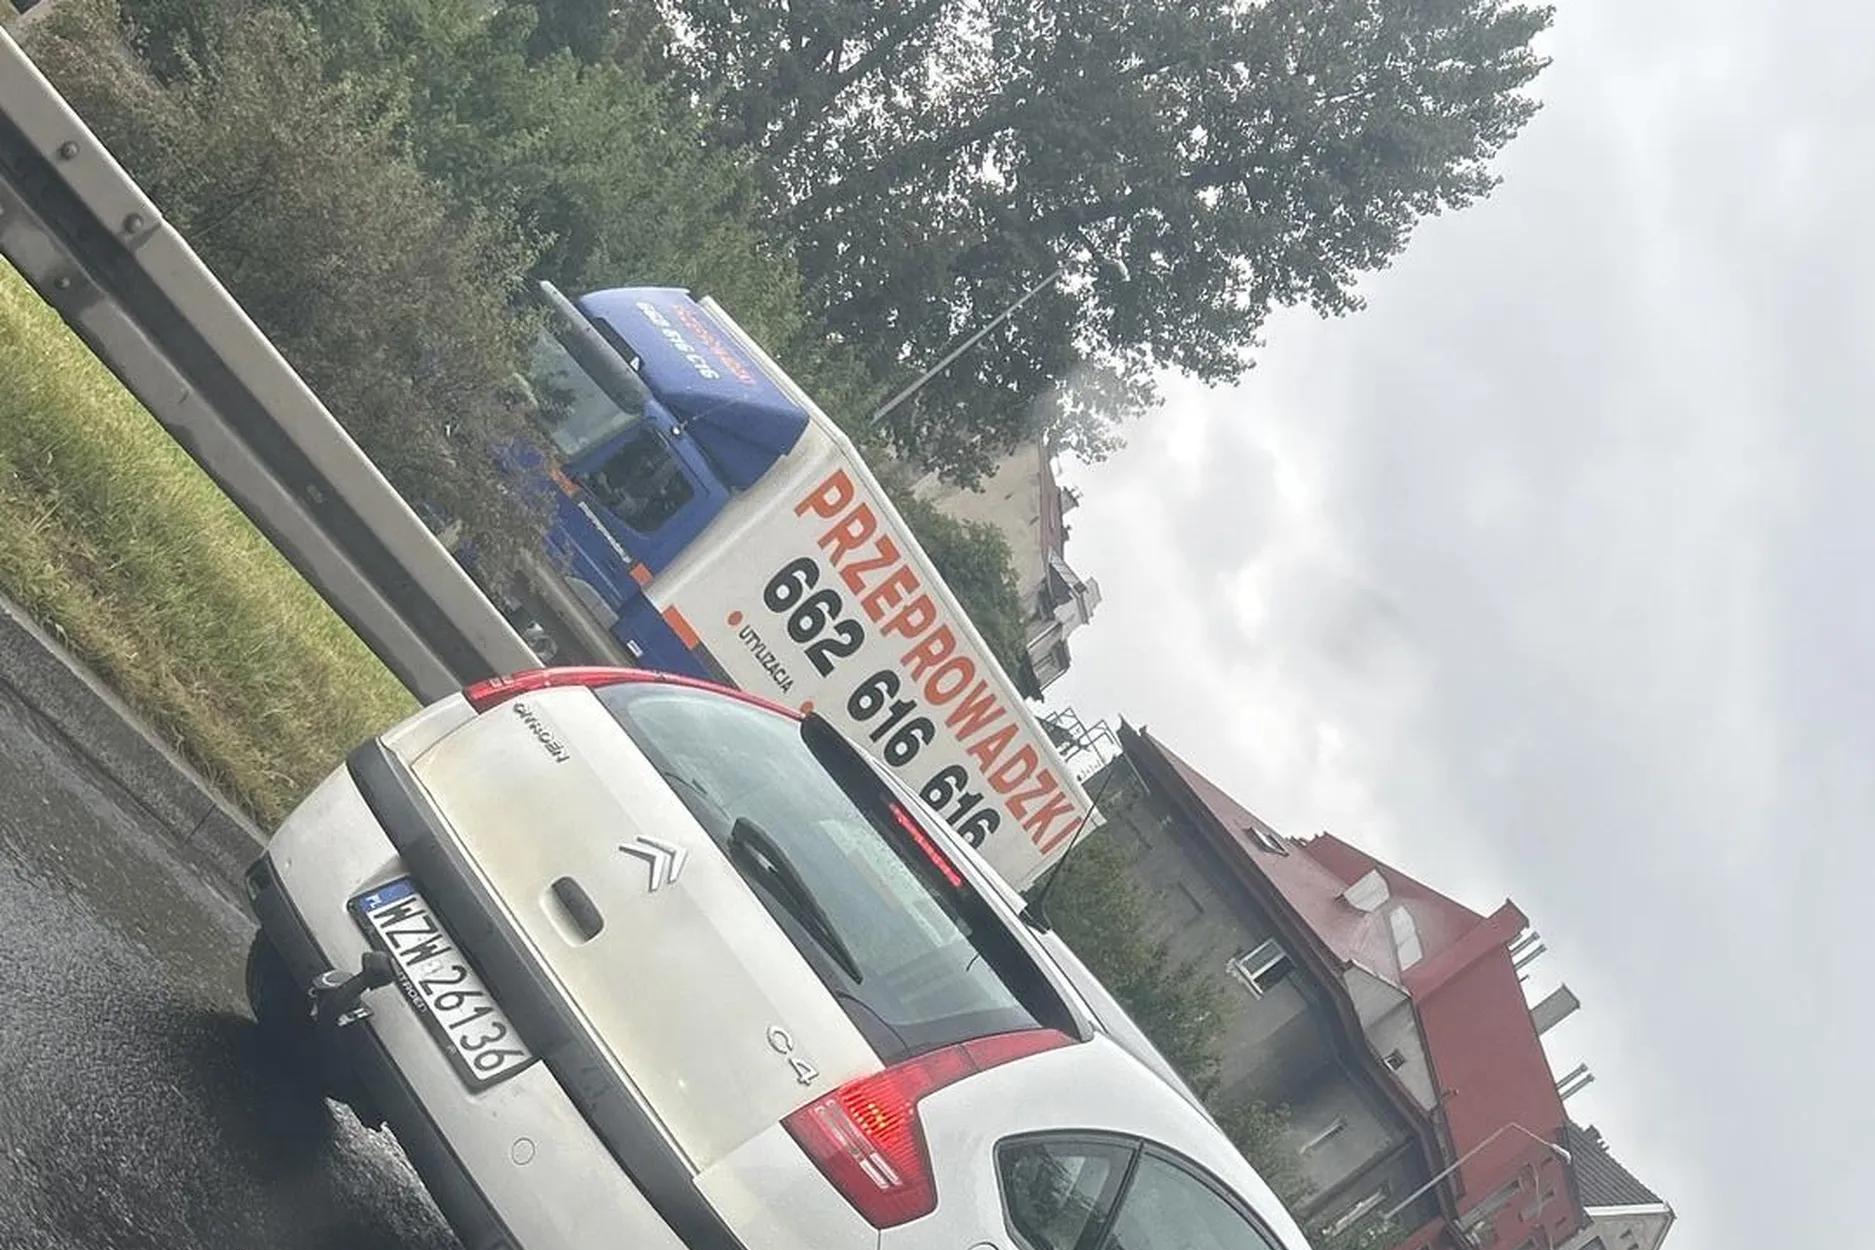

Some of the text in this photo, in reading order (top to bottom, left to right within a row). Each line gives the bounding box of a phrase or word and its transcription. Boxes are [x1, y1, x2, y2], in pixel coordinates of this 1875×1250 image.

[739, 625, 793, 693] UTYLIZACJA
[764, 557, 1001, 850] 662 616 616
[794, 468, 1083, 855] PRZEPROWADZKI
[366, 894, 382, 909] PL
[373, 896, 524, 1072] WZW 26136
